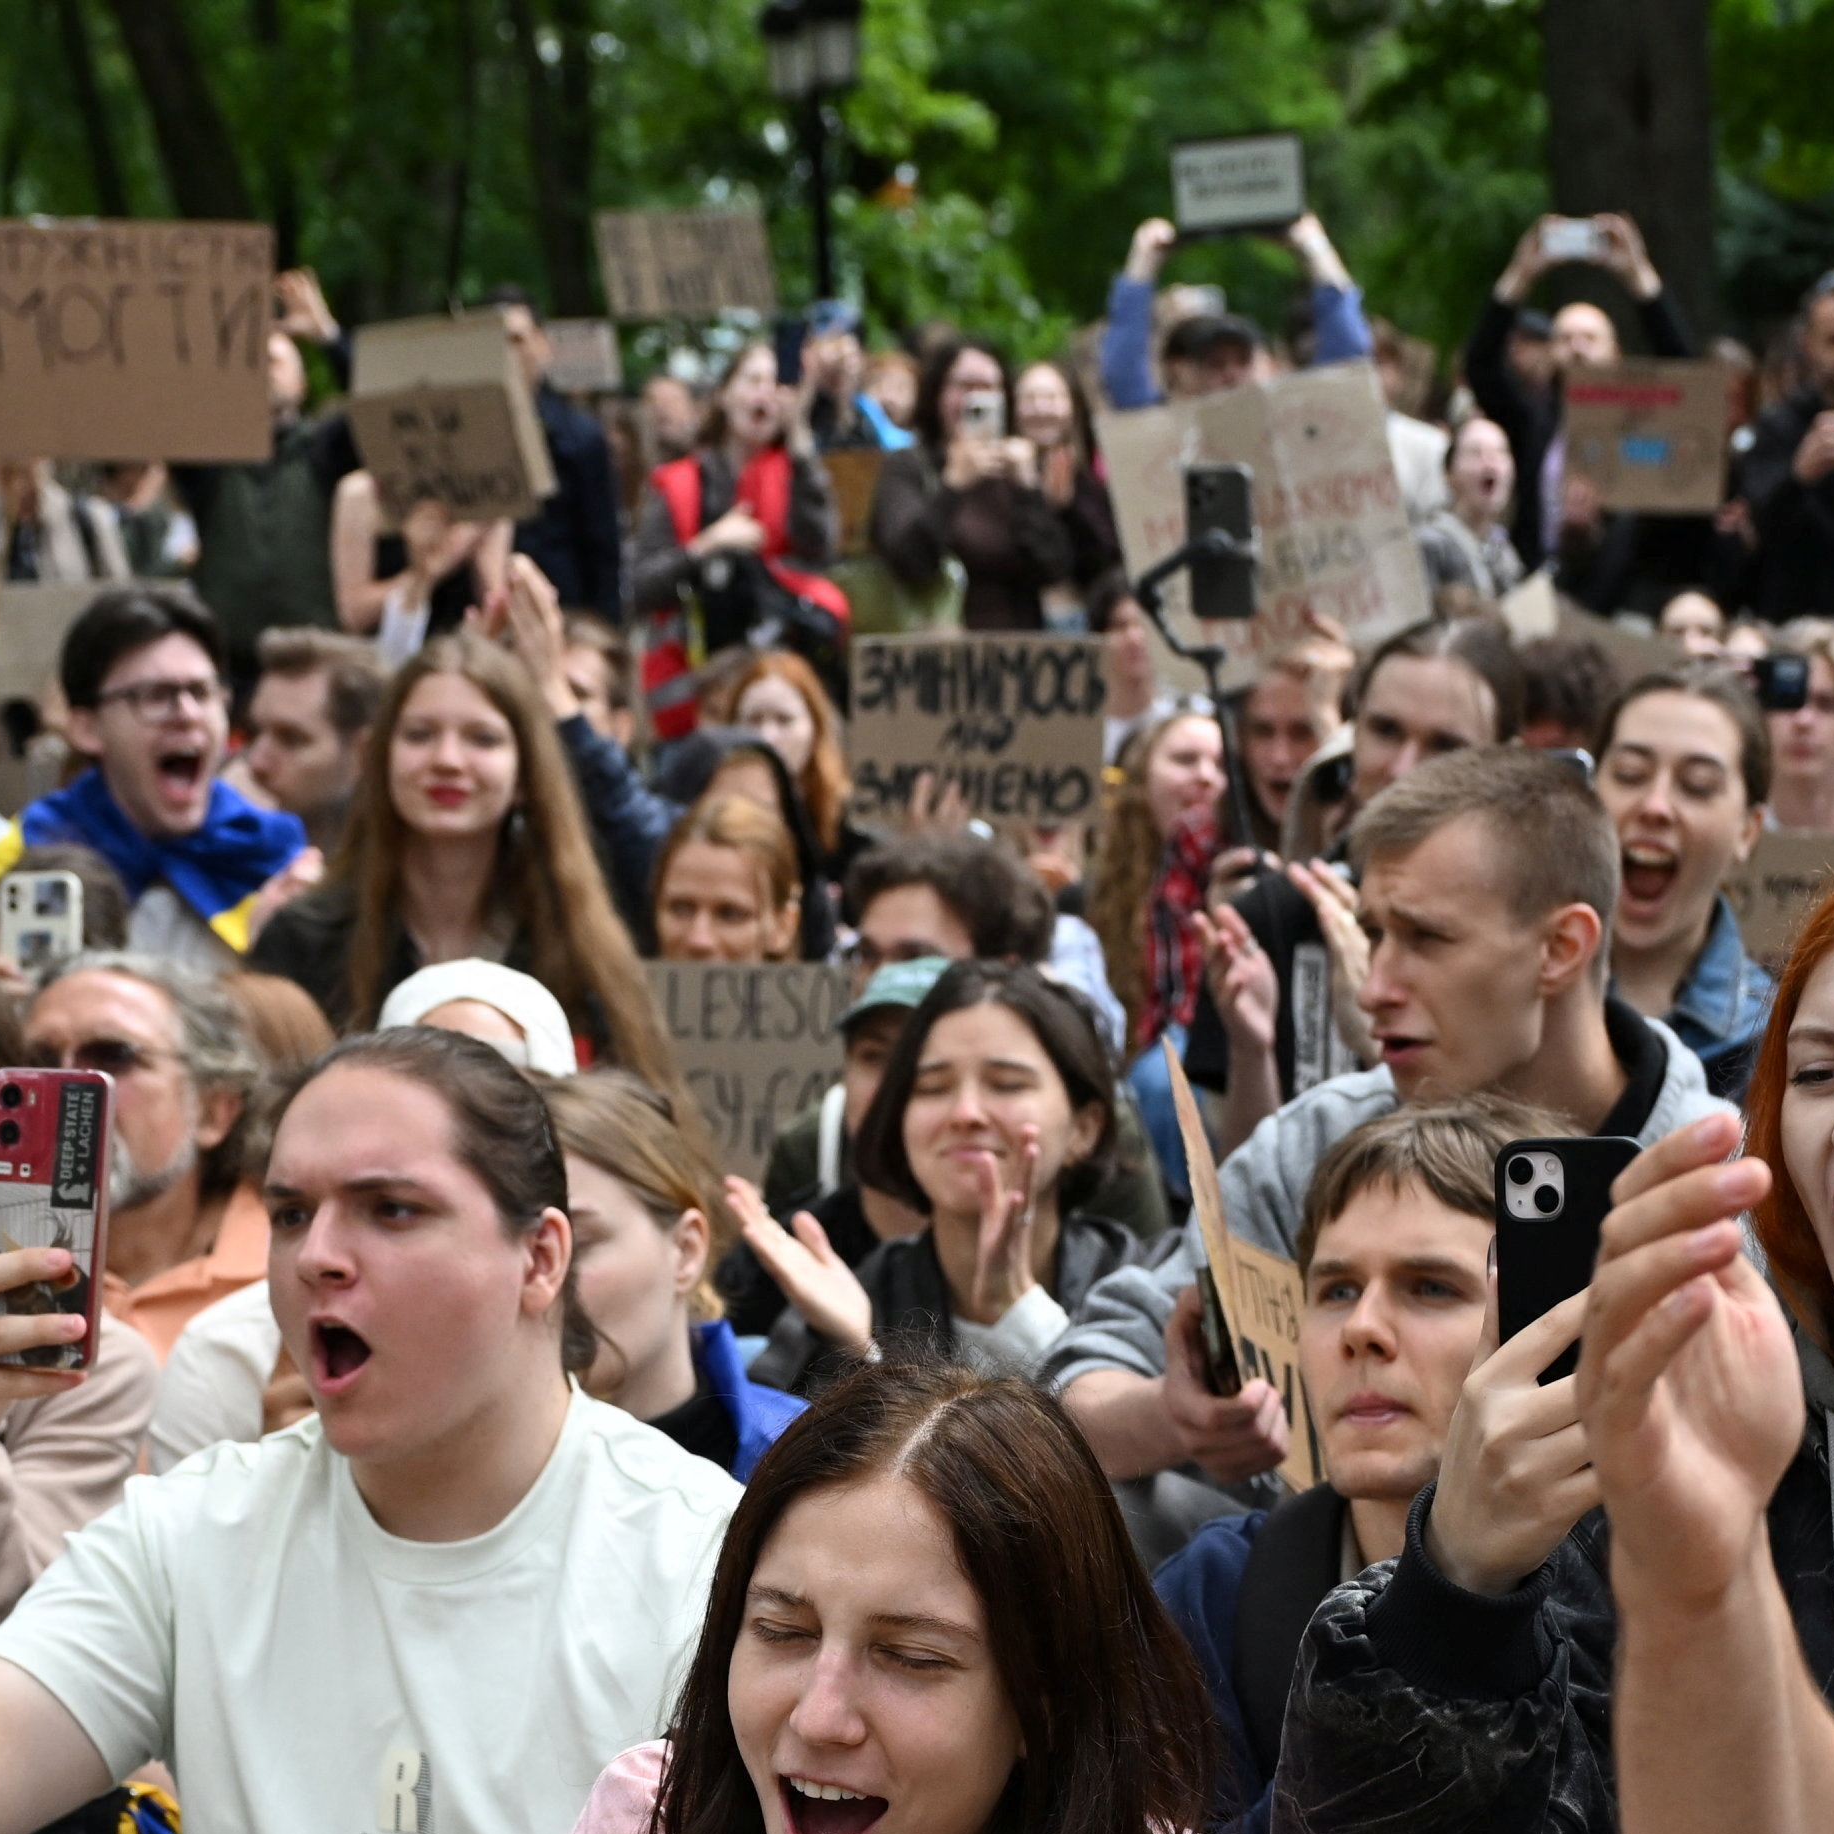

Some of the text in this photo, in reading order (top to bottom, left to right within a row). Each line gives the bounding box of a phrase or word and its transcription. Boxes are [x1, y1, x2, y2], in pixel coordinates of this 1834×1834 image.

[59, 1091, 81, 1180] DEEP STATE
[78, 1092, 95, 1158] LACHEN
